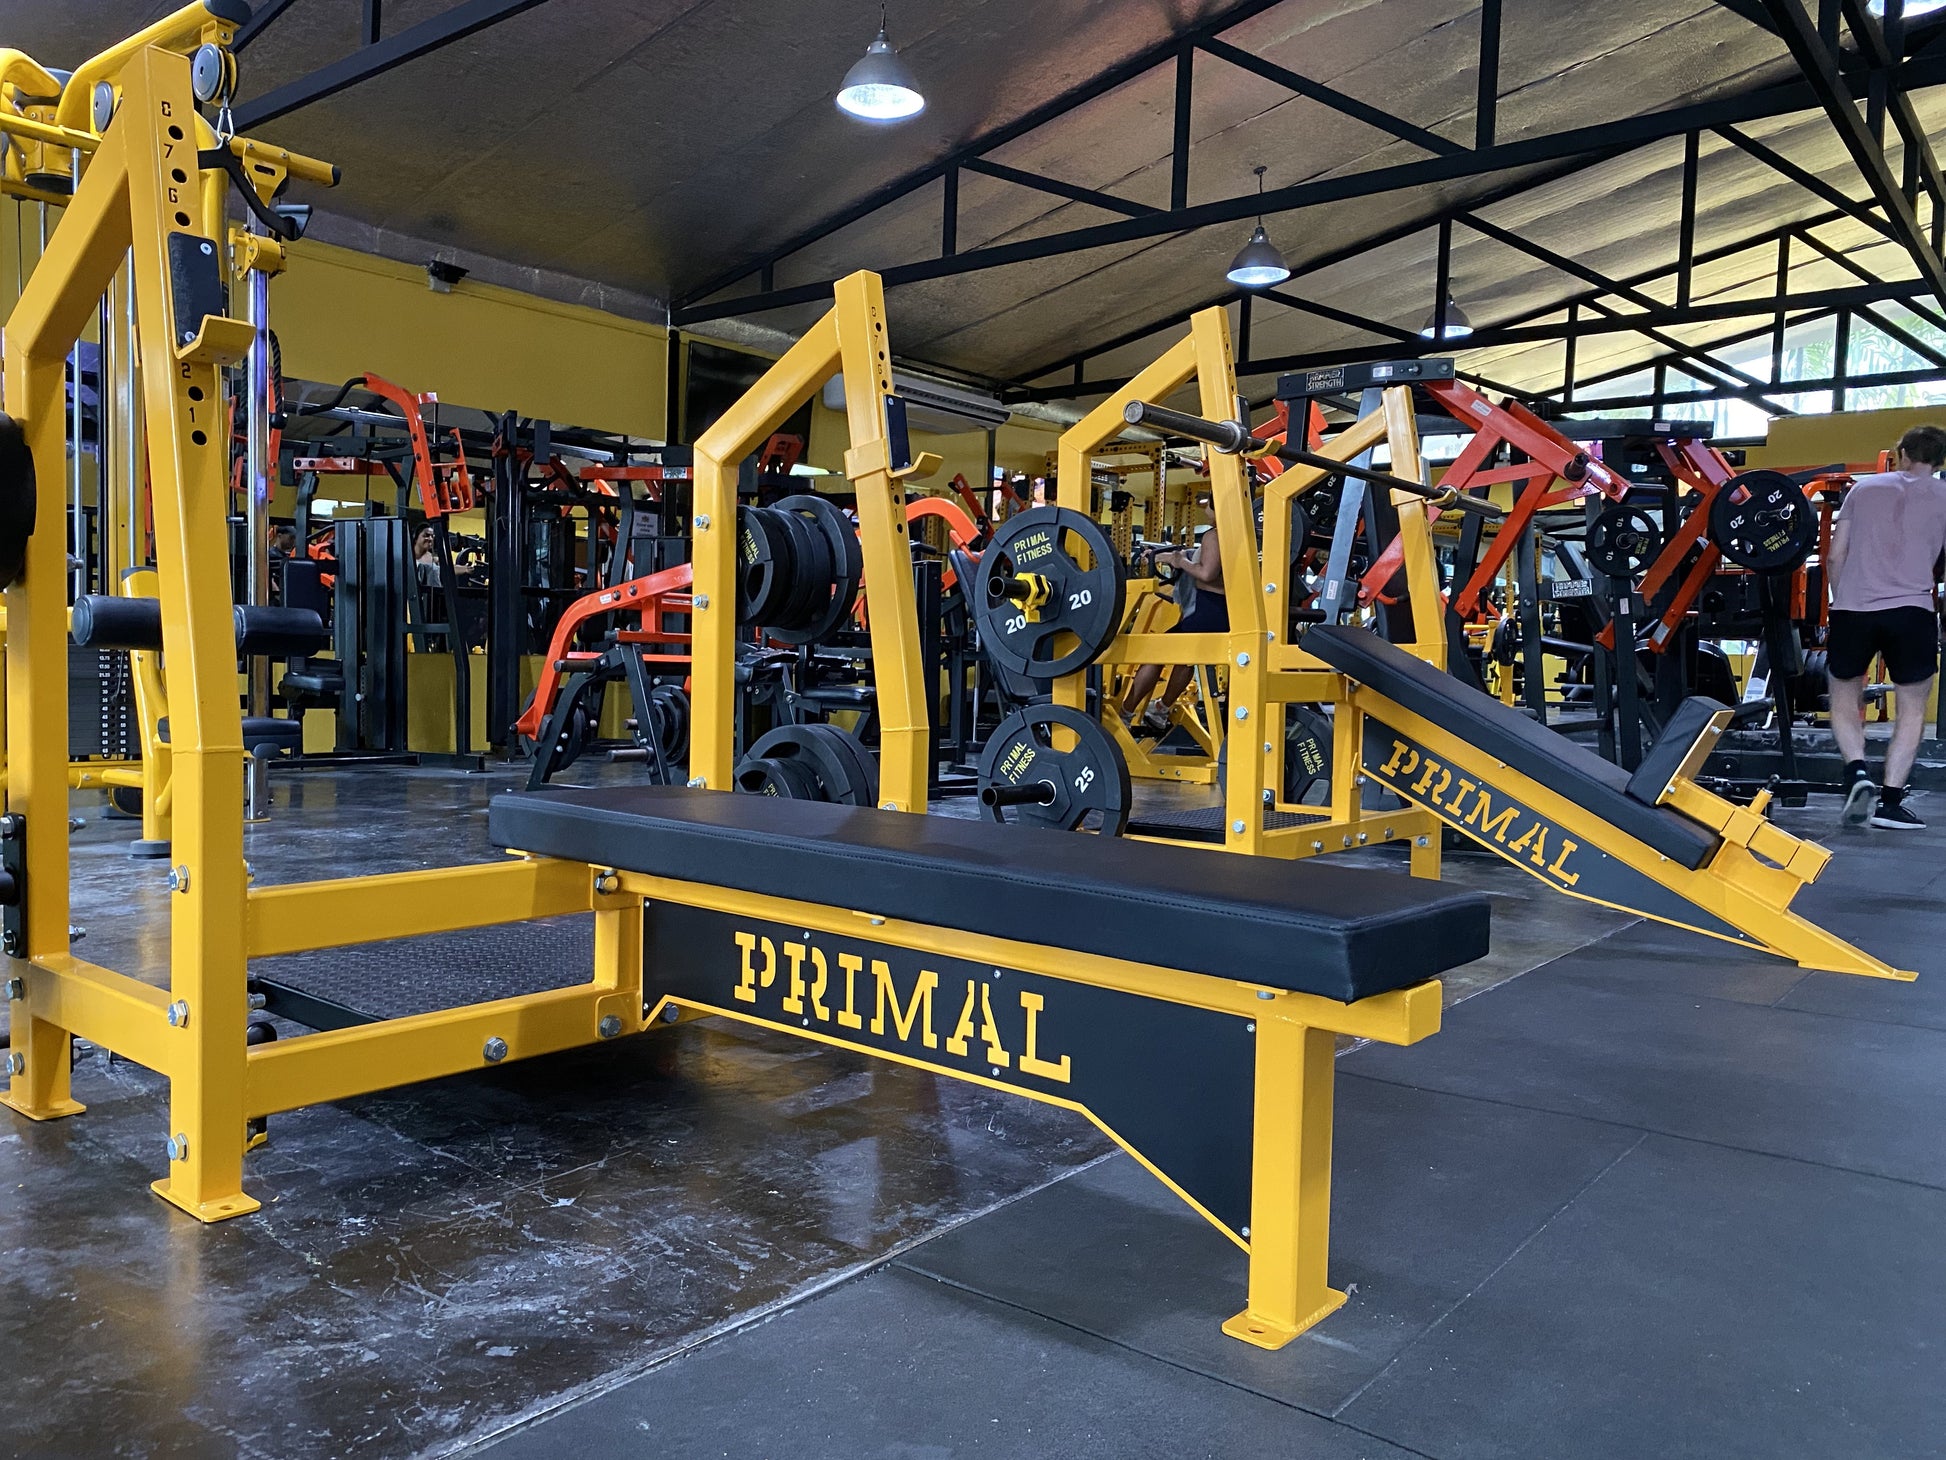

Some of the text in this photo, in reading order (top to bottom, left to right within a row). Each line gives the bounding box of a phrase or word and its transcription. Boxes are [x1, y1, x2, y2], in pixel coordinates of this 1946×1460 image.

[163, 143, 174, 158] 7
[181, 362, 192, 378] 2
[1308, 379, 1342, 391] STRENGTH
[188, 407, 195, 423] 1
[1327, 476, 1337, 487] 20
[1768, 489, 1783, 504] 20
[1310, 504, 1319, 515] 20
[1616, 517, 1624, 528] 10
[1730, 515, 1745, 529] 20
[744, 528, 760, 560] PRIMAL
[1014, 531, 1050, 553] PRIMAL
[1016, 543, 1053, 566] FITNESS
[1605, 550, 1614, 561] 10
[1069, 589, 1092, 610] 20
[1005, 614, 1027, 635] 20
[1000, 741, 1027, 776] PRIMAL
[1297, 742, 1317, 775] FITNESS
[1306, 738, 1325, 772] PRIMAL
[1008, 748, 1036, 785] FITNESS
[1074, 766, 1095, 794] 25
[1379, 740, 1580, 886] PRIMAL
[734, 931, 1071, 1083] PRIMAL
